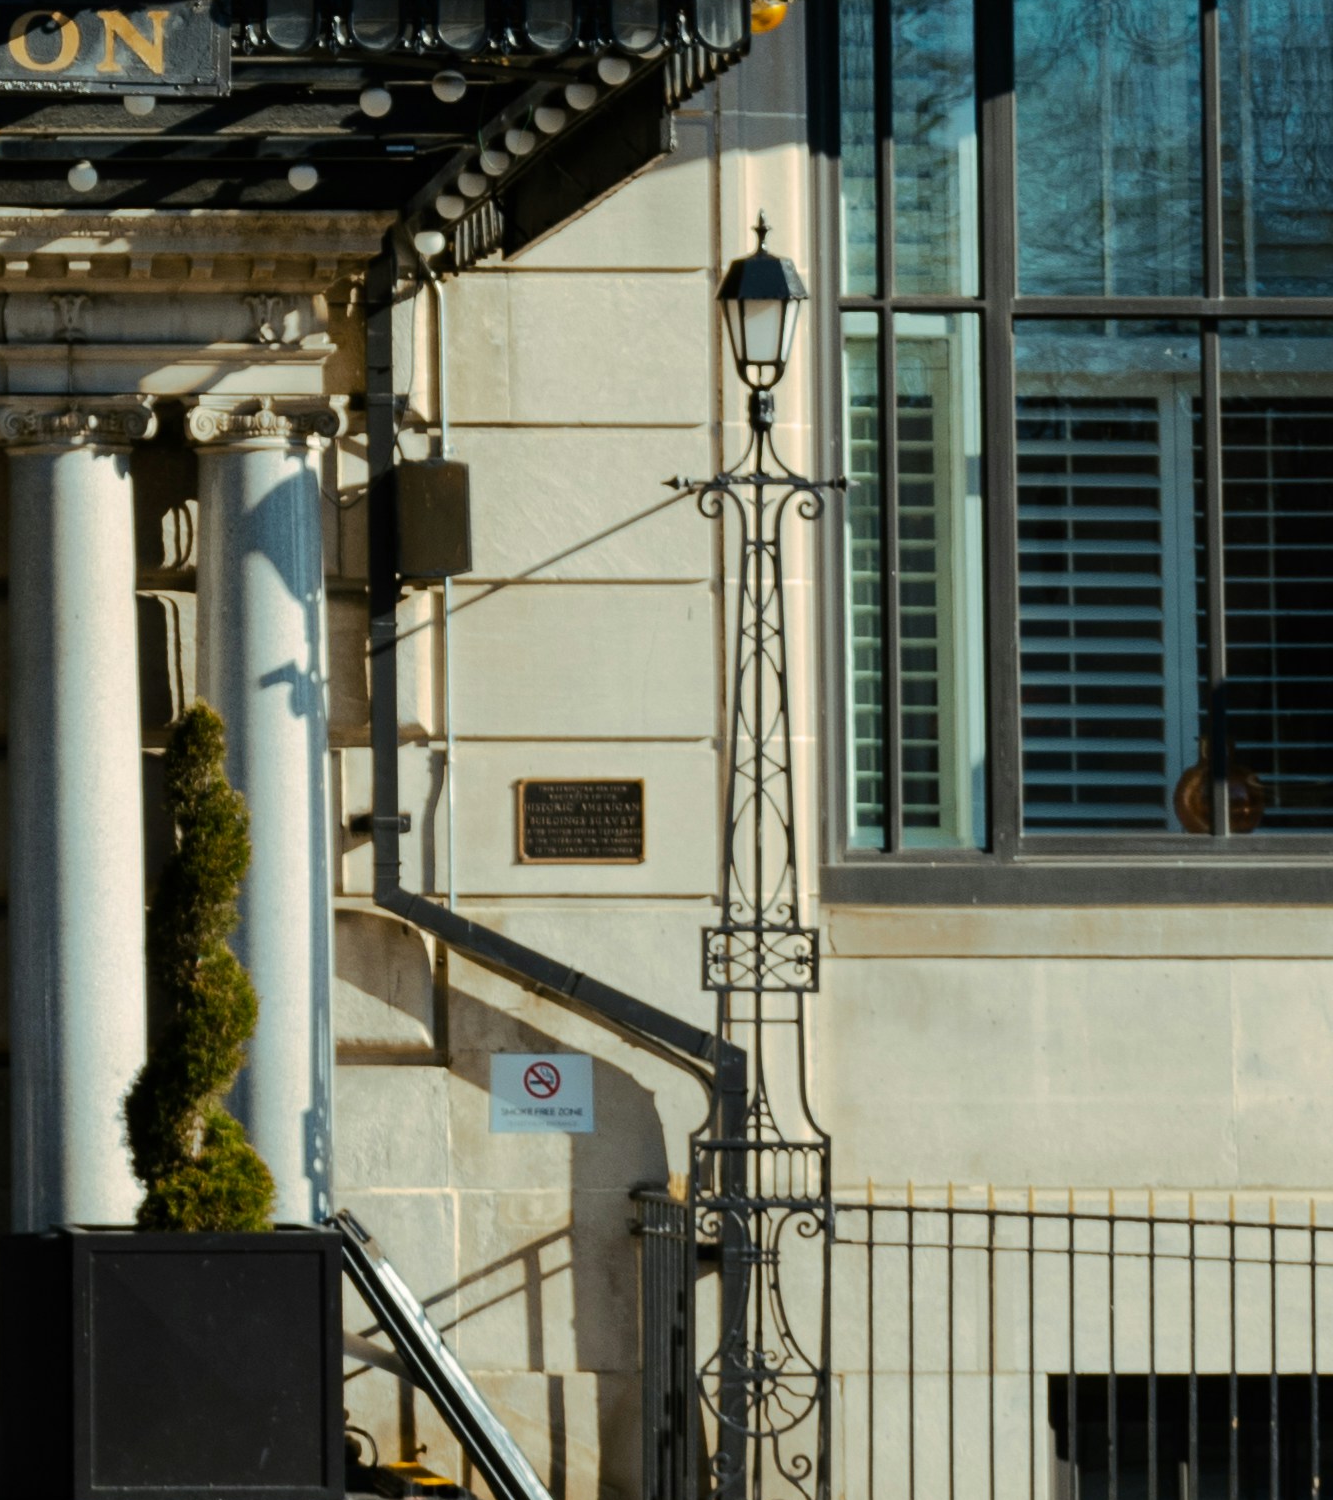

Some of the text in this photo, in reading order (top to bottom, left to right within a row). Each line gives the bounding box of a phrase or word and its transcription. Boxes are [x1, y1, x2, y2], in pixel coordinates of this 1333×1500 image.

[523, 803, 639, 812] HISTORIC AMERICAN
[530, 816, 635, 825] BUILDINGS SURVEY
[501, 1107, 583, 1116] SMOKE FREE ZONE
